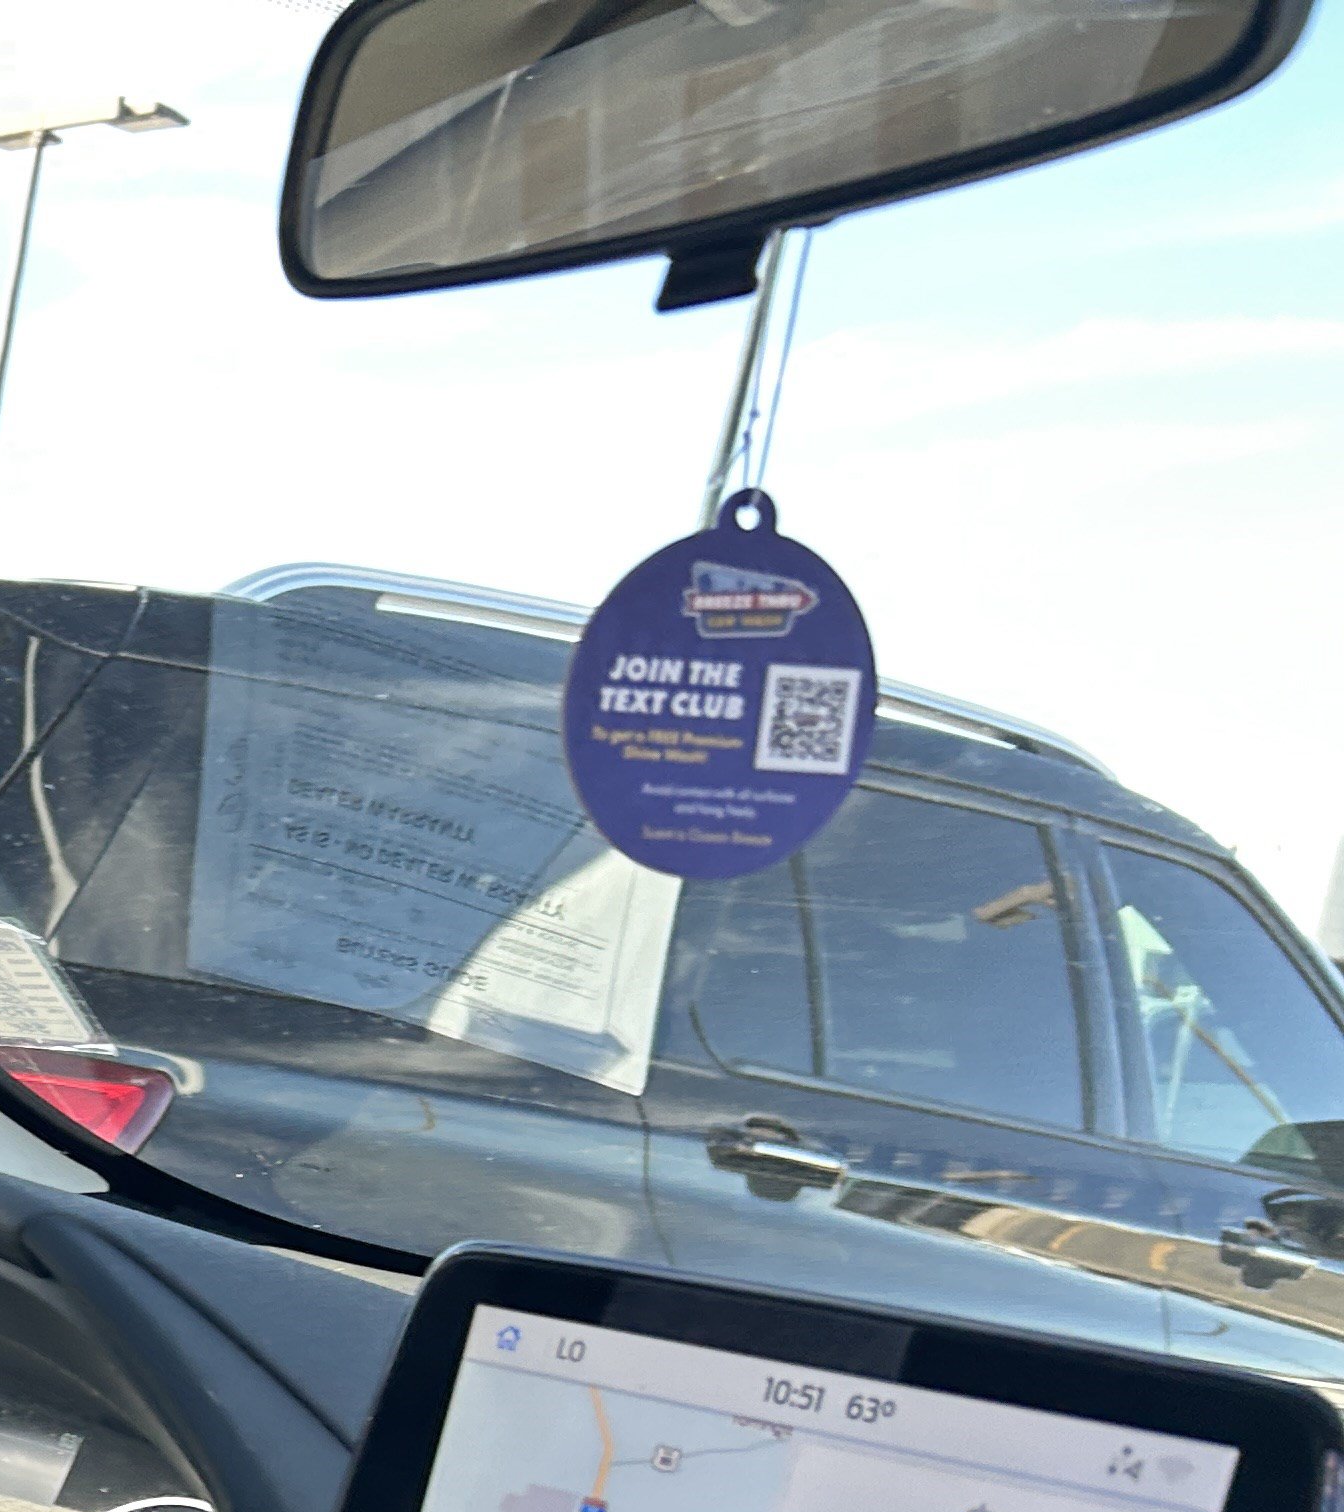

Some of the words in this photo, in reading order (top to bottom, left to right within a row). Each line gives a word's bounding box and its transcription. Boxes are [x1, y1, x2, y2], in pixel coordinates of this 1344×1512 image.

[609, 655, 684, 684] JOIN
[688, 660, 744, 688] THE
[598, 686, 667, 715] TEXT
[670, 691, 745, 720] CLUB
[556, 1337, 586, 1362] LO
[762, 1376, 825, 1414] 10:51
